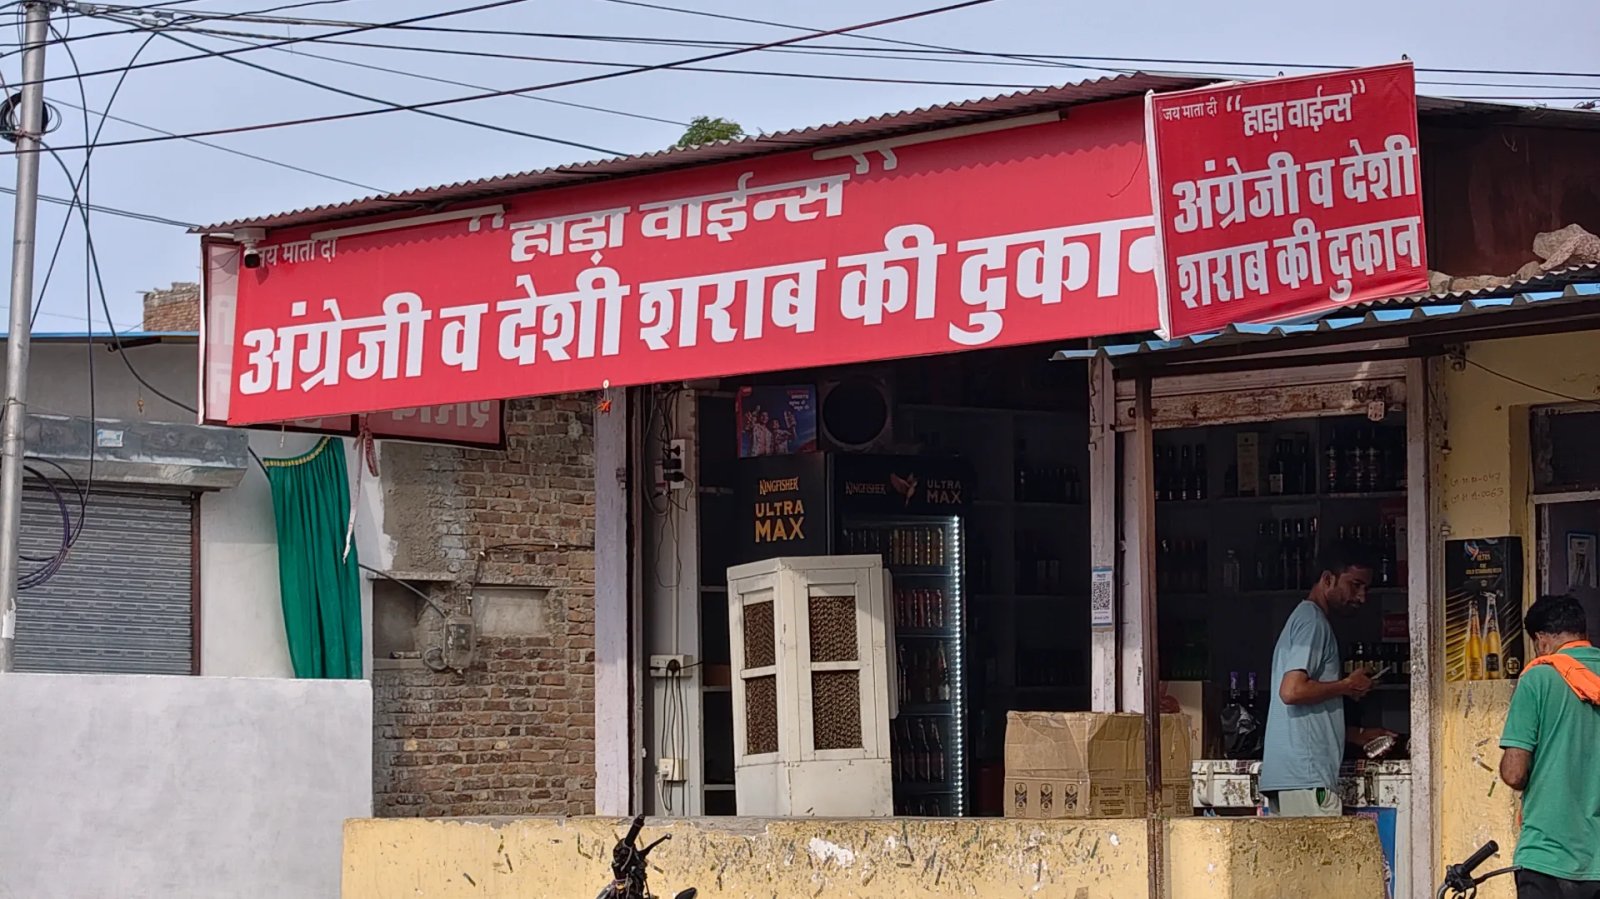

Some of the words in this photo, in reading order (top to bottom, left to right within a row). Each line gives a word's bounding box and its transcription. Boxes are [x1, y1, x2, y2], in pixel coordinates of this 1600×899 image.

[1162, 106, 1181, 121] जय
[1182, 102, 1204, 118] माता
[1205, 96, 1218, 117] दी
[1171, 151, 1301, 233] अंग्रेजी
[1304, 159, 1336, 209] व
[1339, 134, 1417, 203] देशी
[281, 240, 318, 264] माता
[1176, 240, 1269, 309] शराब
[1272, 217, 1322, 290] की
[1324, 215, 1421, 303] दुकान
[239, 292, 432, 395] अंग्रेजी
[440, 303, 488, 372] व
[497, 266, 631, 366] देशी
[639, 259, 826, 350] शराब
[837, 223, 947, 325] की
[759, 476, 799, 495] KINGFISHER
[926, 479, 962, 489] ULTRA
[755, 499, 804, 518] ULTRA
[926, 489, 962, 504] MAX
[755, 517, 805, 543] MAX
